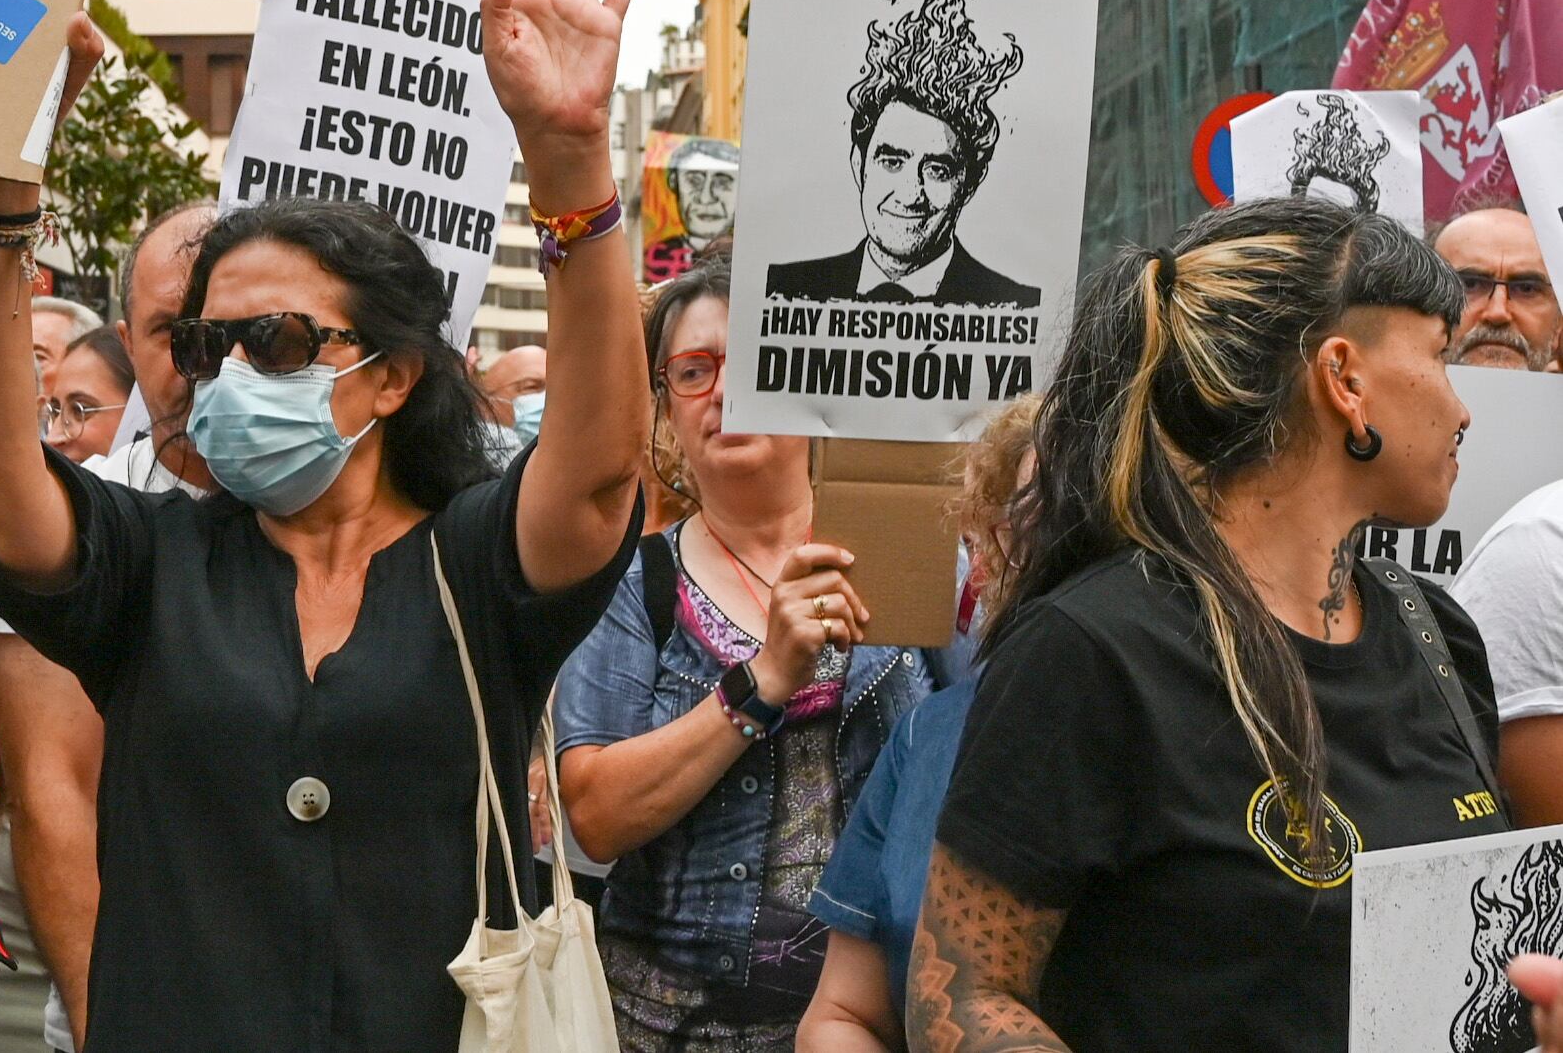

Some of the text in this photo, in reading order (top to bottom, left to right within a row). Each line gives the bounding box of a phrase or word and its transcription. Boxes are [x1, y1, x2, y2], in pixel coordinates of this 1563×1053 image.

[319, 39, 471, 118] EN LEÓN.
[299, 104, 469, 181] ¡ESTO NO
[377, 182, 496, 256] VOLVER
[760, 306, 1039, 345] ¡HAY RESPONSABLES!
[756, 343, 1033, 401] DIMISIÓN YA
[1411, 528, 1463, 576] LA
